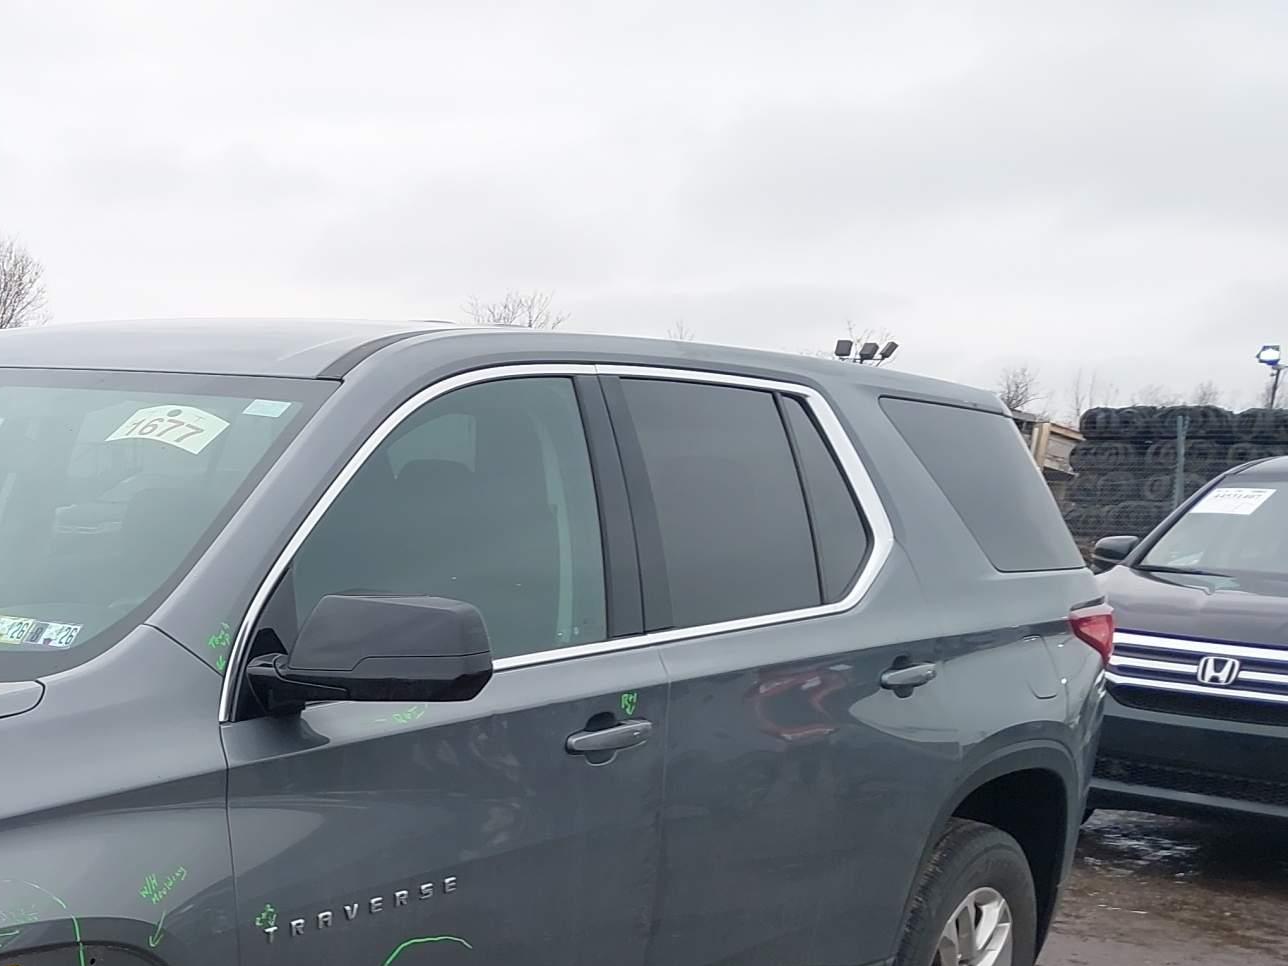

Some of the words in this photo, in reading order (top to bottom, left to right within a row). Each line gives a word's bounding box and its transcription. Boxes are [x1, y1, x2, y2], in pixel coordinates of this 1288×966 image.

[125, 417, 205, 443] 1677
[58, 626, 78, 645] 26
[263, 876, 457, 944] TRAVERSE
